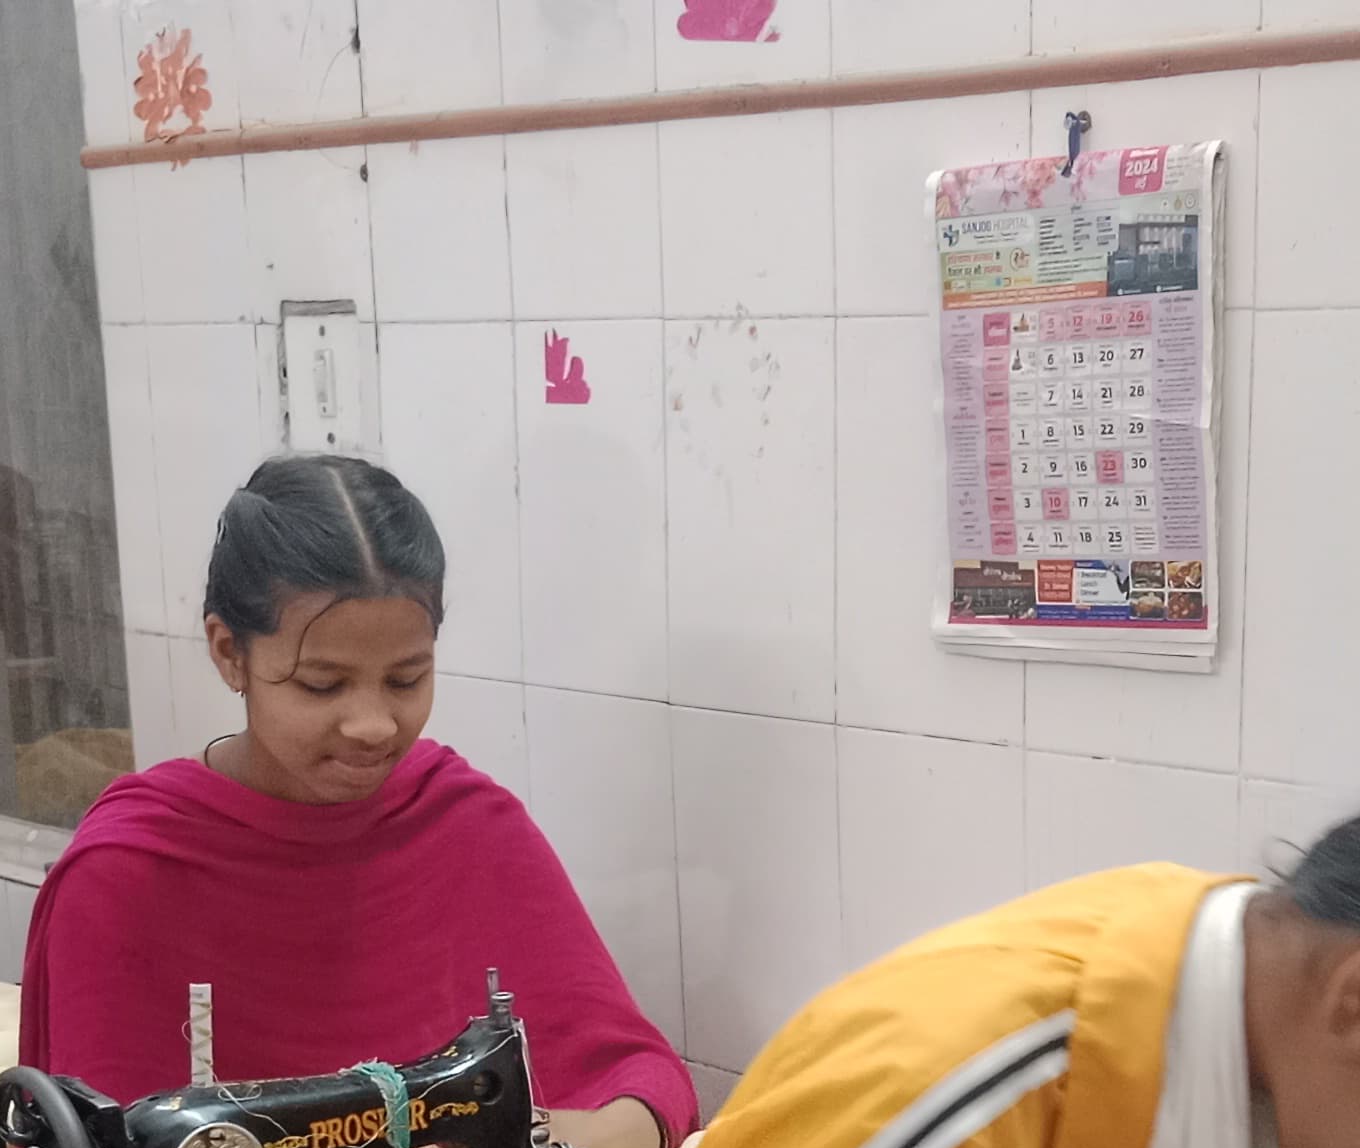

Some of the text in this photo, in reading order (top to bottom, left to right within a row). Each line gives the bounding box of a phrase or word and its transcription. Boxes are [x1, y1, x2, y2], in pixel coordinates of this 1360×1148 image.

[1125, 158, 1158, 177] 2024
[1073, 316, 1083, 327] 12
[1101, 313, 1113, 325] 19
[1128, 311, 1144, 322] 26
[1047, 348, 1145, 365] 6 13 20 27
[1047, 386, 1145, 402] 7 14 21 28
[1021, 422, 1144, 440] 1 8 15 22 29
[1022, 458, 1147, 474] 2 9 16 23 30
[1024, 495, 1147, 509] 3 10 17 24 31
[1027, 532, 1034, 543] 4
[1054, 532, 1062, 543] 11
[1080, 531, 1092, 542] 18
[1108, 531, 1122, 542] 25
